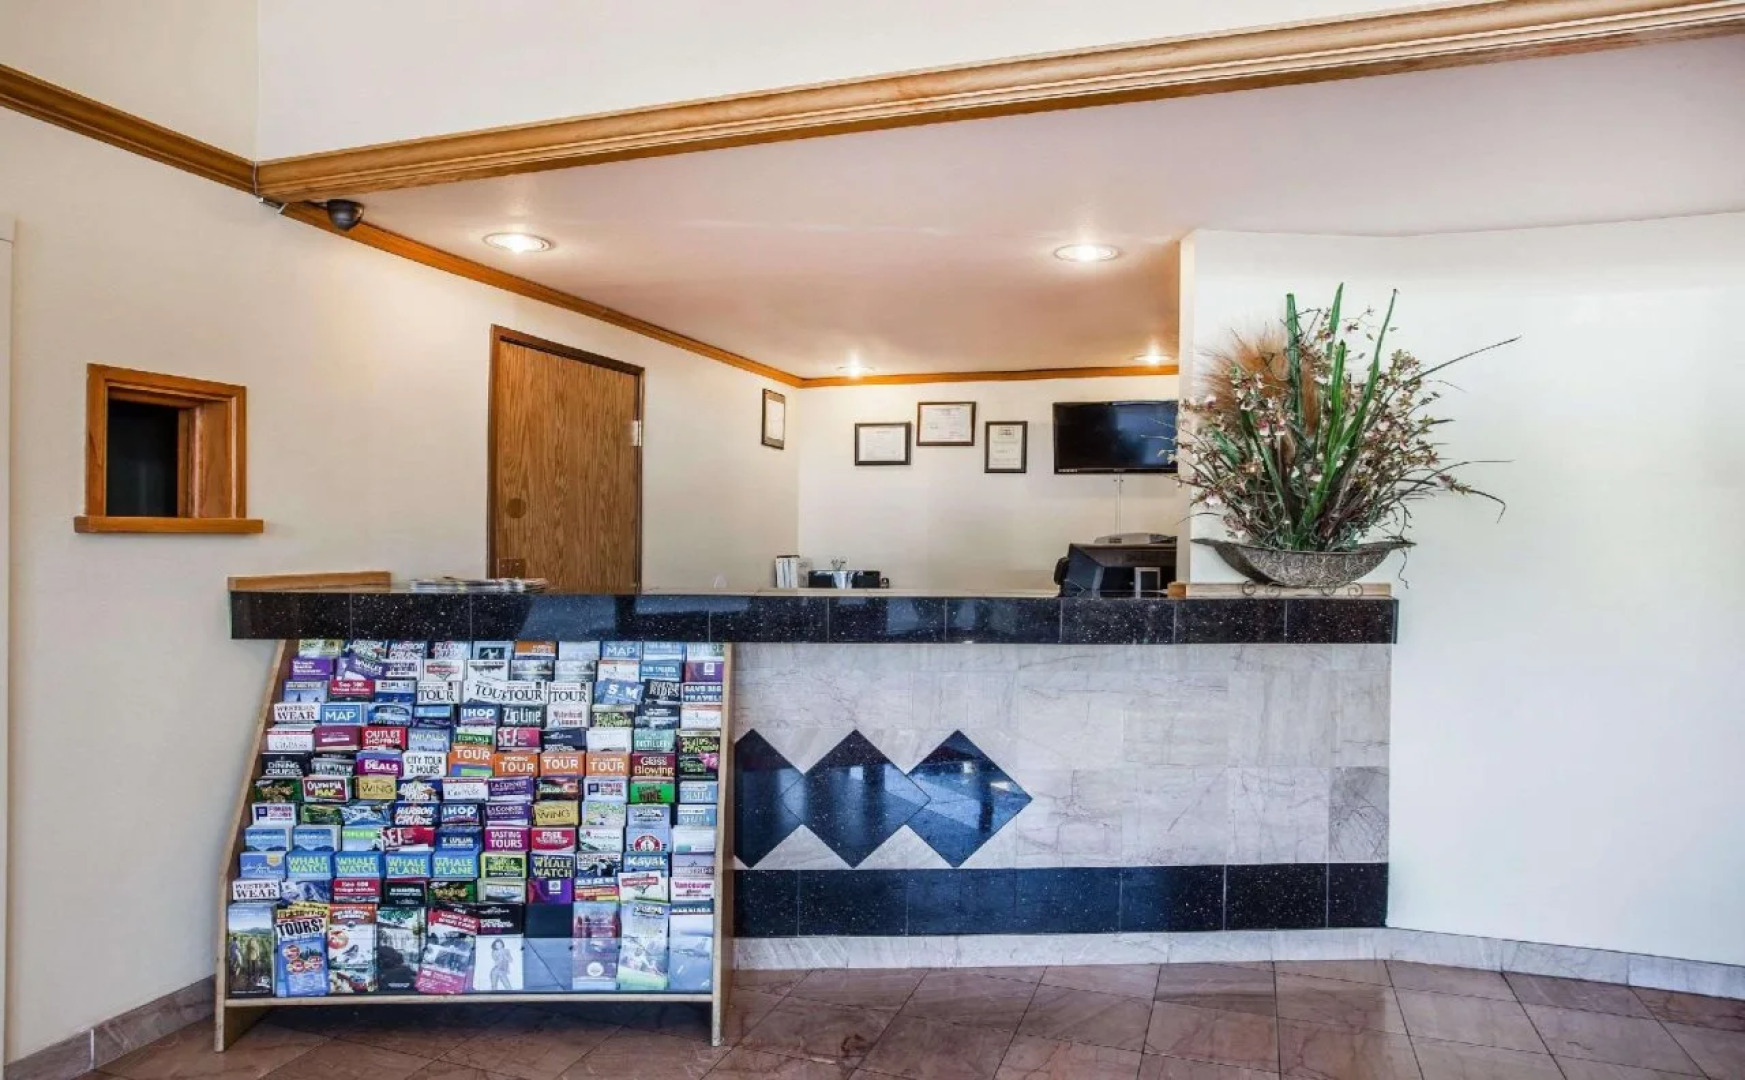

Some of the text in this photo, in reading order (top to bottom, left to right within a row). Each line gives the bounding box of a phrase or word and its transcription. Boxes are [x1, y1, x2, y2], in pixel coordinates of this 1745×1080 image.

[606, 647, 635, 656] MAP
[418, 689, 455, 701] TOUR
[506, 689, 543, 701] TOUR
[551, 690, 587, 702] TOUR
[277, 711, 316, 720] WEAR
[325, 711, 356, 721] MAP
[365, 730, 401, 738] OUTLET
[457, 749, 491, 760] TOUR
[365, 759, 399, 771] DEALS
[406, 756, 443, 765] CITY TOUR
[543, 758, 579, 769] TOUR
[417, 766, 441, 774] HOURS
[501, 762, 535, 772] TOUR
[589, 761, 625, 772] TOUR
[634, 765, 674, 776] Blowing
[397, 806, 435, 815] HARBOR
[395, 815, 433, 824] CRUISE
[491, 838, 522, 848] TOURS
[288, 856, 327, 865] WHALE
[336, 856, 376, 865] WHALE
[388, 858, 426, 867] WHALE
[435, 857, 473, 866] WHALE
[534, 858, 572, 868] WHALE
[627, 857, 667, 869] Kayak
[289, 864, 329, 873] WATCH
[337, 864, 377, 873] WATCH
[388, 866, 427, 875] PLANE
[434, 866, 473, 875] PLANE
[534, 867, 572, 878] WATCH
[236, 889, 276, 898] WEAR
